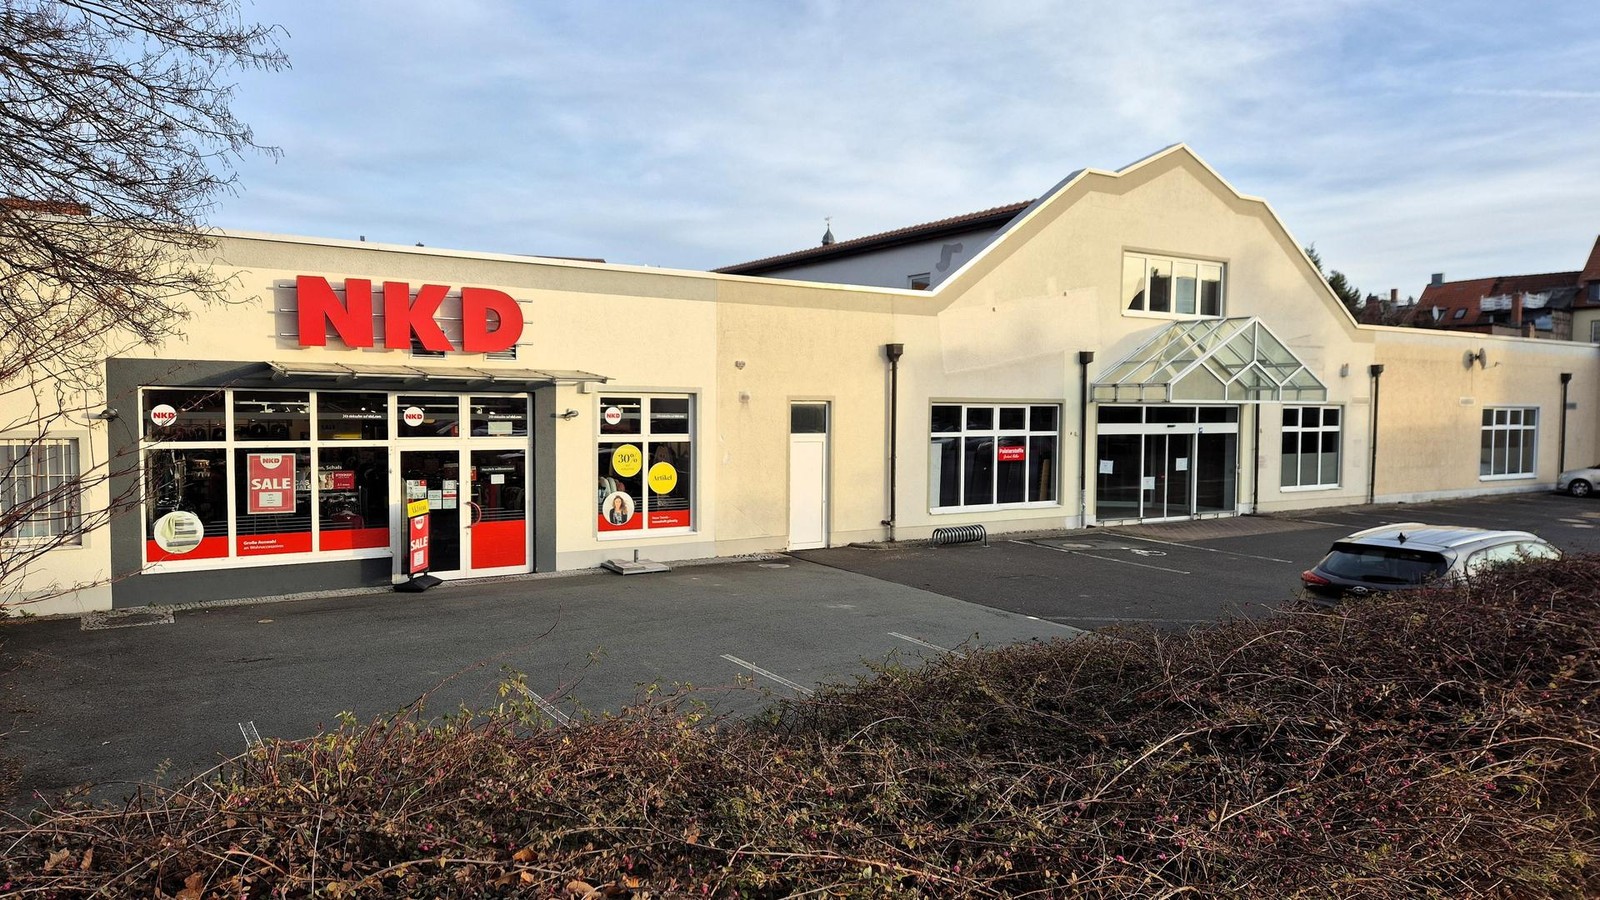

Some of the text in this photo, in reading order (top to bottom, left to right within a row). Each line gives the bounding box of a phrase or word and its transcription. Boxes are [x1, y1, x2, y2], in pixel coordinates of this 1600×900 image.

[296, 275, 524, 352] NKD
[618, 453, 638, 464] 30%
[251, 478, 291, 490] SALE
[410, 537, 428, 551] SALE
